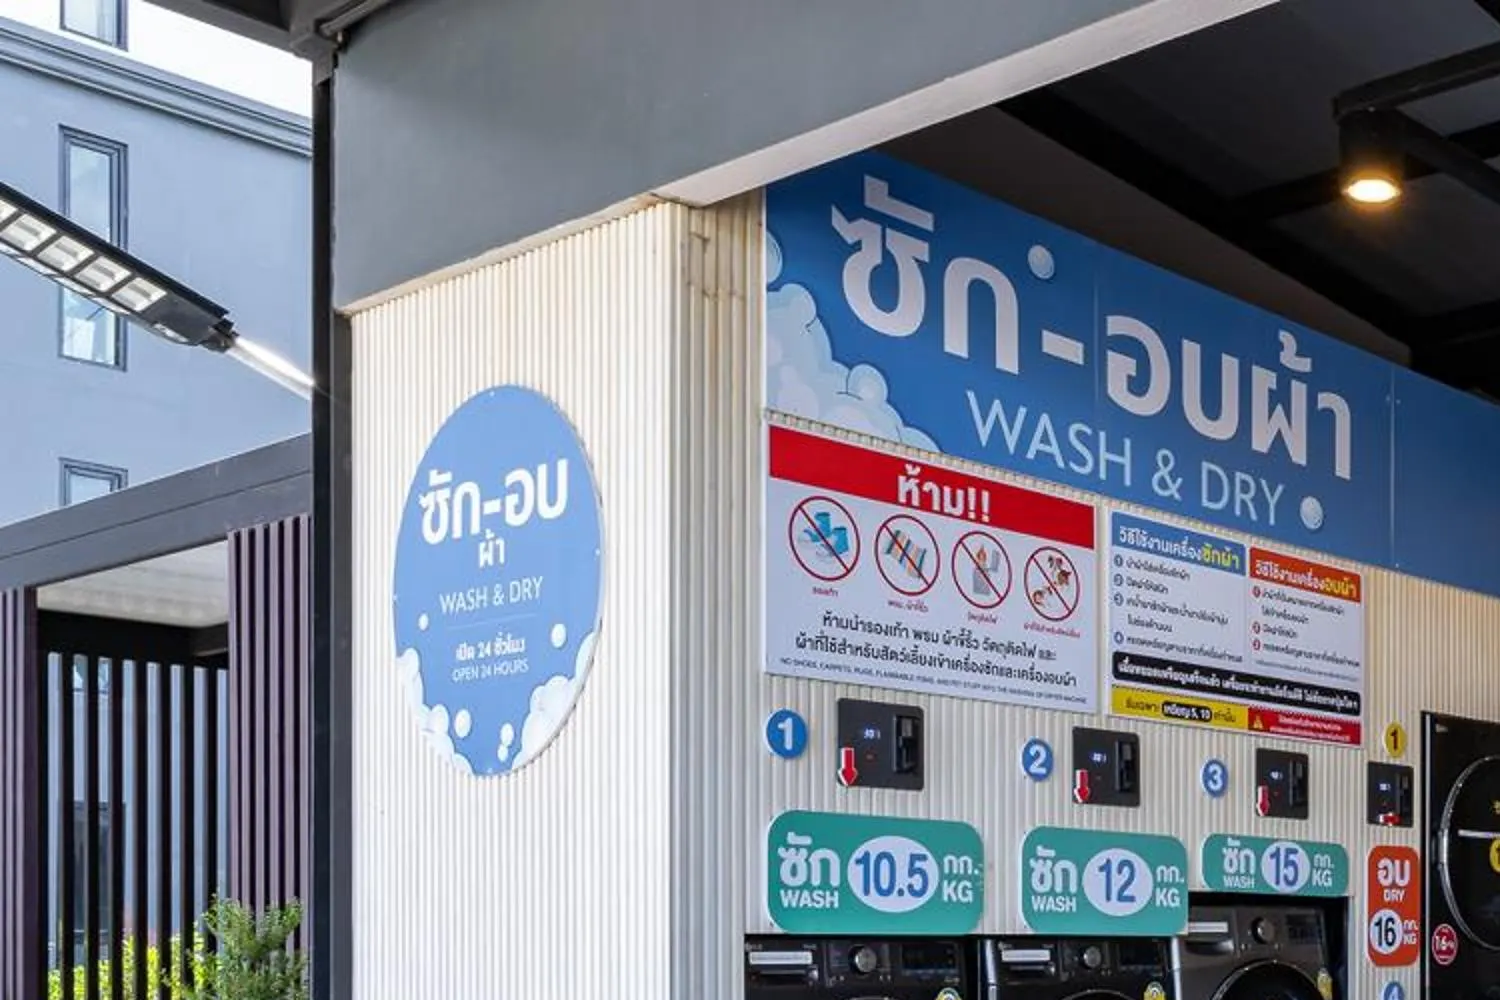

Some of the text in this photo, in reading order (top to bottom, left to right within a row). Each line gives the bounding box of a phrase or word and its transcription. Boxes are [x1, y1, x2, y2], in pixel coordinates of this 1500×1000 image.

[966, 390, 1284, 527] WASH & DRY
[419, 459, 568, 545] ซัก-อบ
[897, 463, 991, 522] ห้าม!!
[479, 531, 505, 569] ผ้า
[440, 576, 544, 616] WASH & DRY
[822, 610, 909, 639] ห้ามนำรองเท้า
[456, 641, 475, 660] เปิด
[478, 641, 491, 658] 24
[452, 657, 529, 683] OPEN 24 HOURS
[778, 717, 793, 750] 1
[1391, 729, 1398, 750] 1
[1029, 744, 1047, 774] 2
[1211, 763, 1223, 791] 3
[777, 832, 980, 897] ซัก 10.5 กก.
[1029, 845, 1184, 903] ซัก 12 กก.
[1222, 838, 1334, 886] ซัก 15 กก.
[1377, 857, 1410, 887] อบ
[942, 880, 974, 903] KG
[1223, 875, 1255, 889] WASH
[1312, 869, 1332, 887] KG
[780, 889, 839, 908] WASH
[1031, 896, 1076, 912] WASH
[1155, 887, 1180, 908] KG
[1383, 889, 1405, 902] DRY
[1374, 916, 1396, 946] 16
